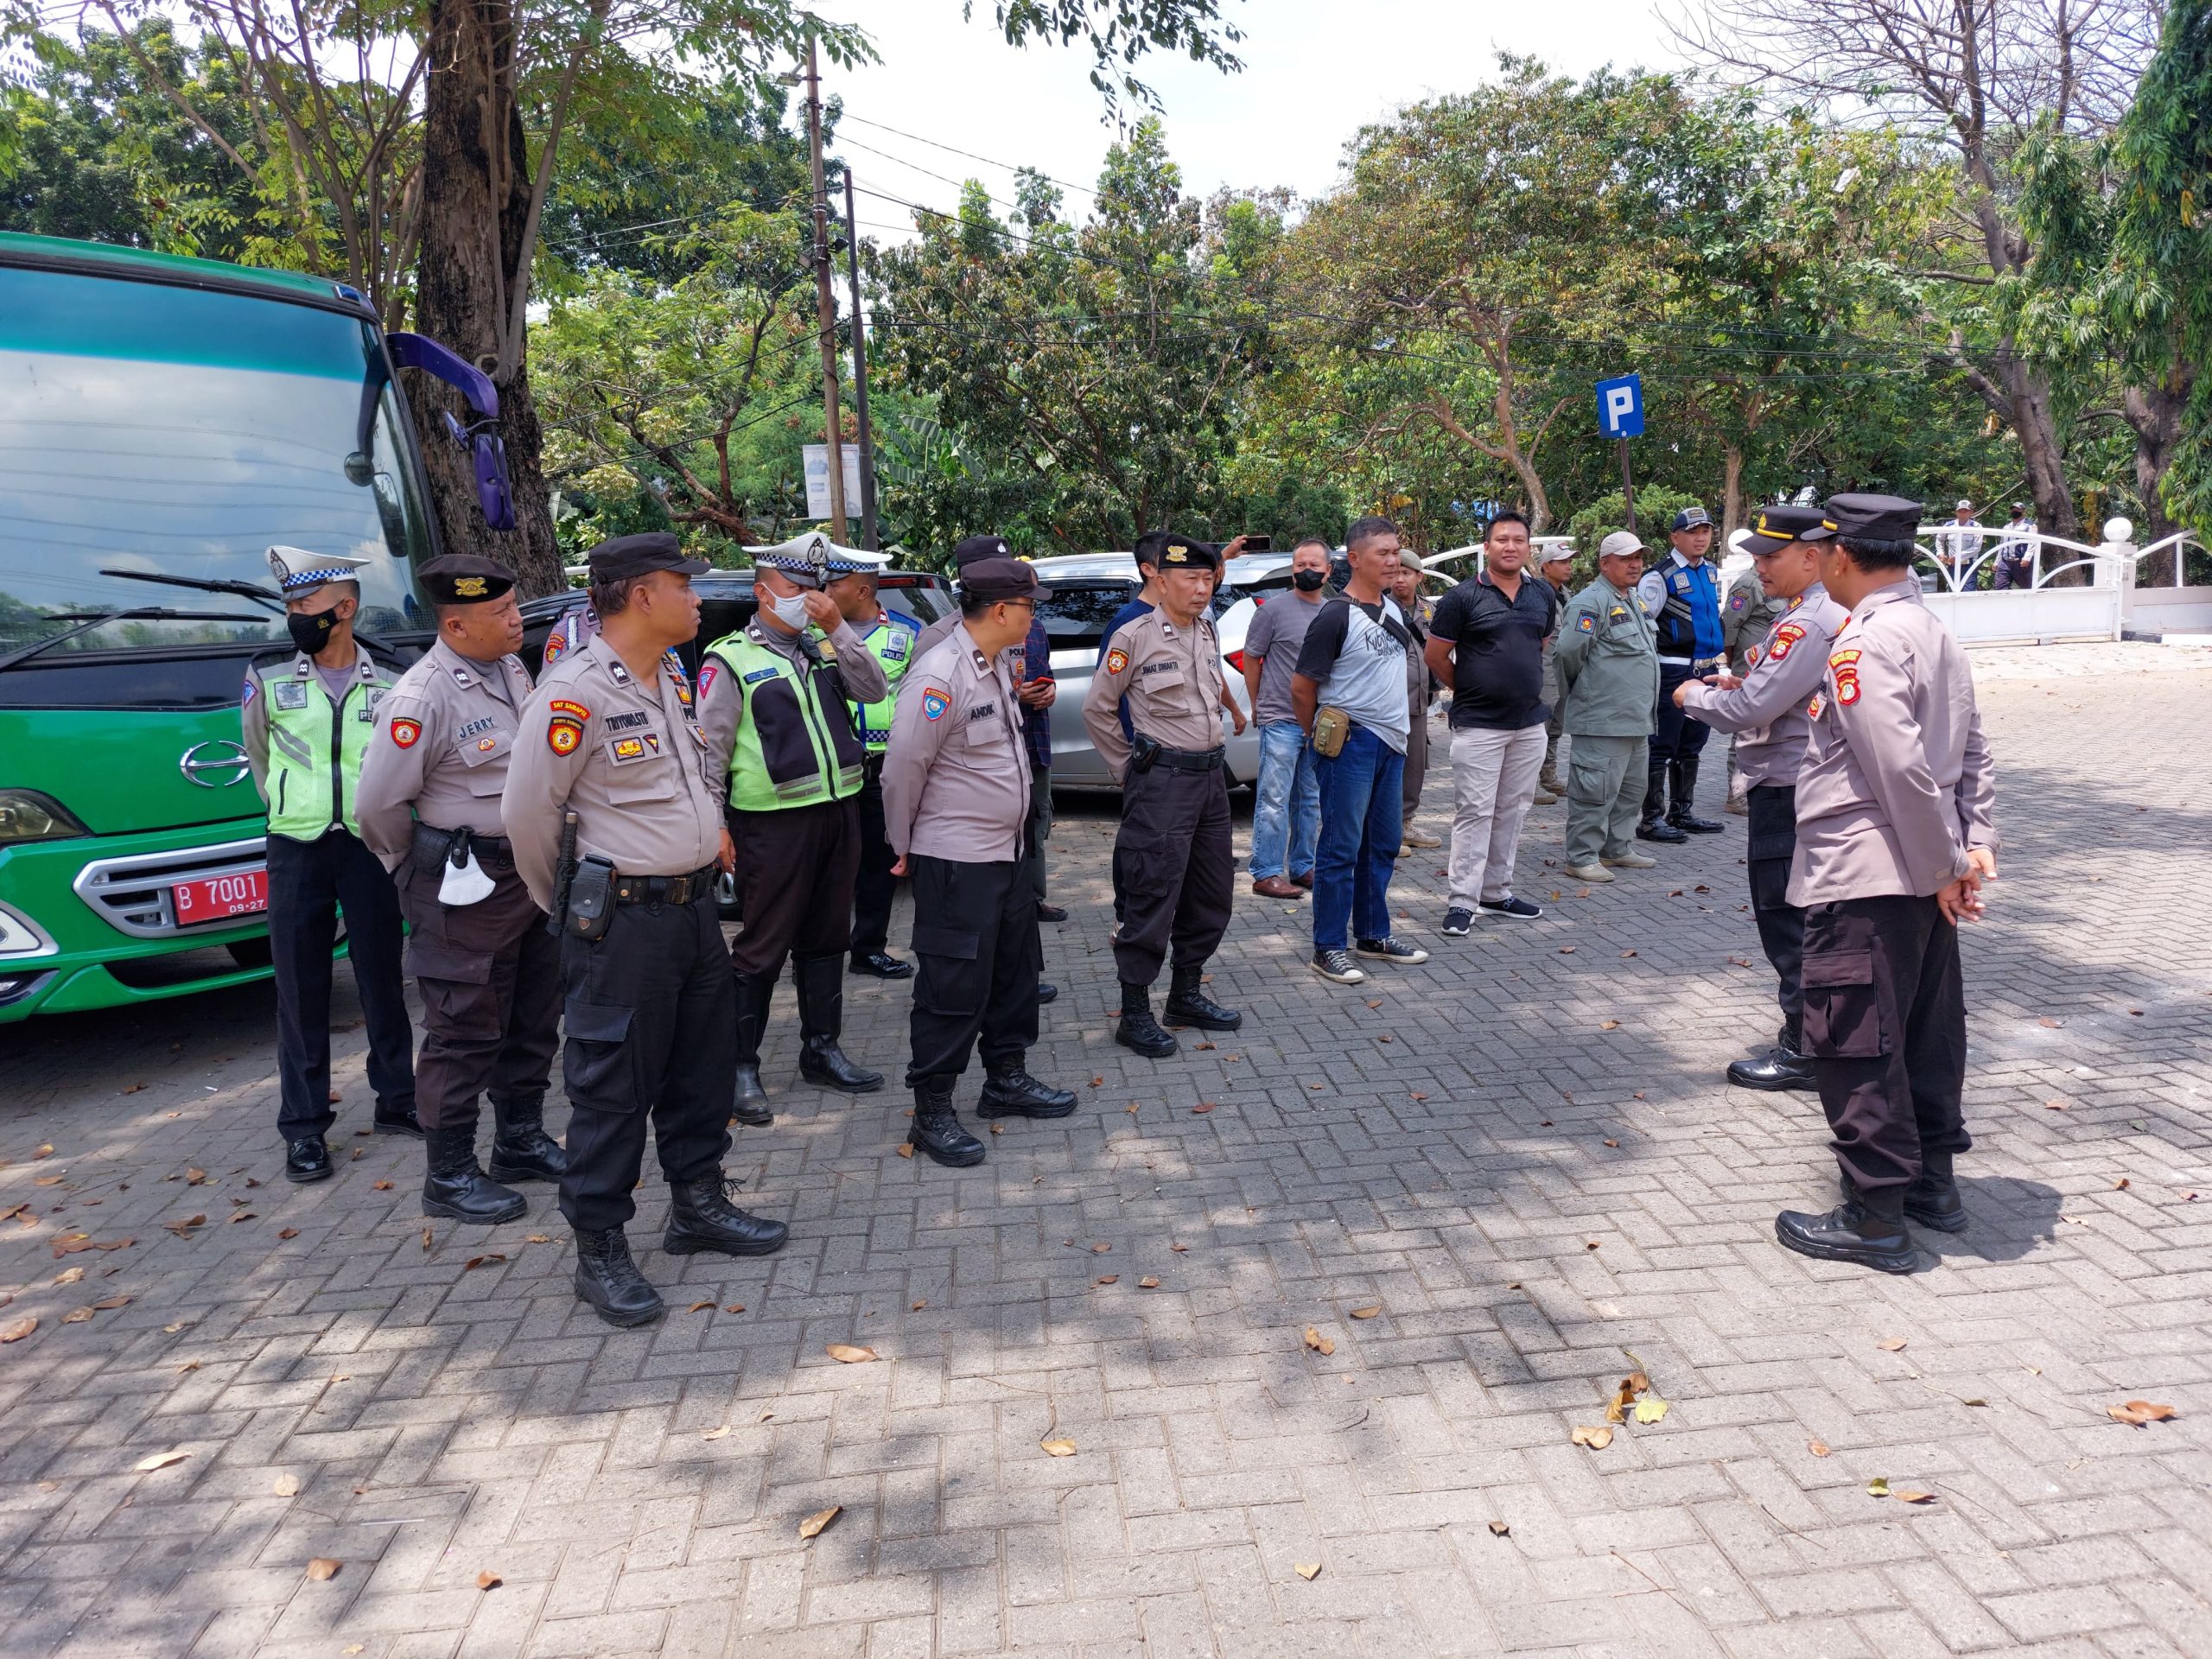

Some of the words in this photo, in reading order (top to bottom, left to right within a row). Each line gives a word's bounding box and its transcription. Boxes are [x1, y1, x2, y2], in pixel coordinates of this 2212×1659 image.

[1606, 385, 1634, 431] P
[881, 649, 905, 661] POLISI
[969, 702, 995, 721] ANDIK
[459, 716, 495, 739] JERRY
[179, 887, 193, 910] B
[205, 874, 257, 905] 7001
